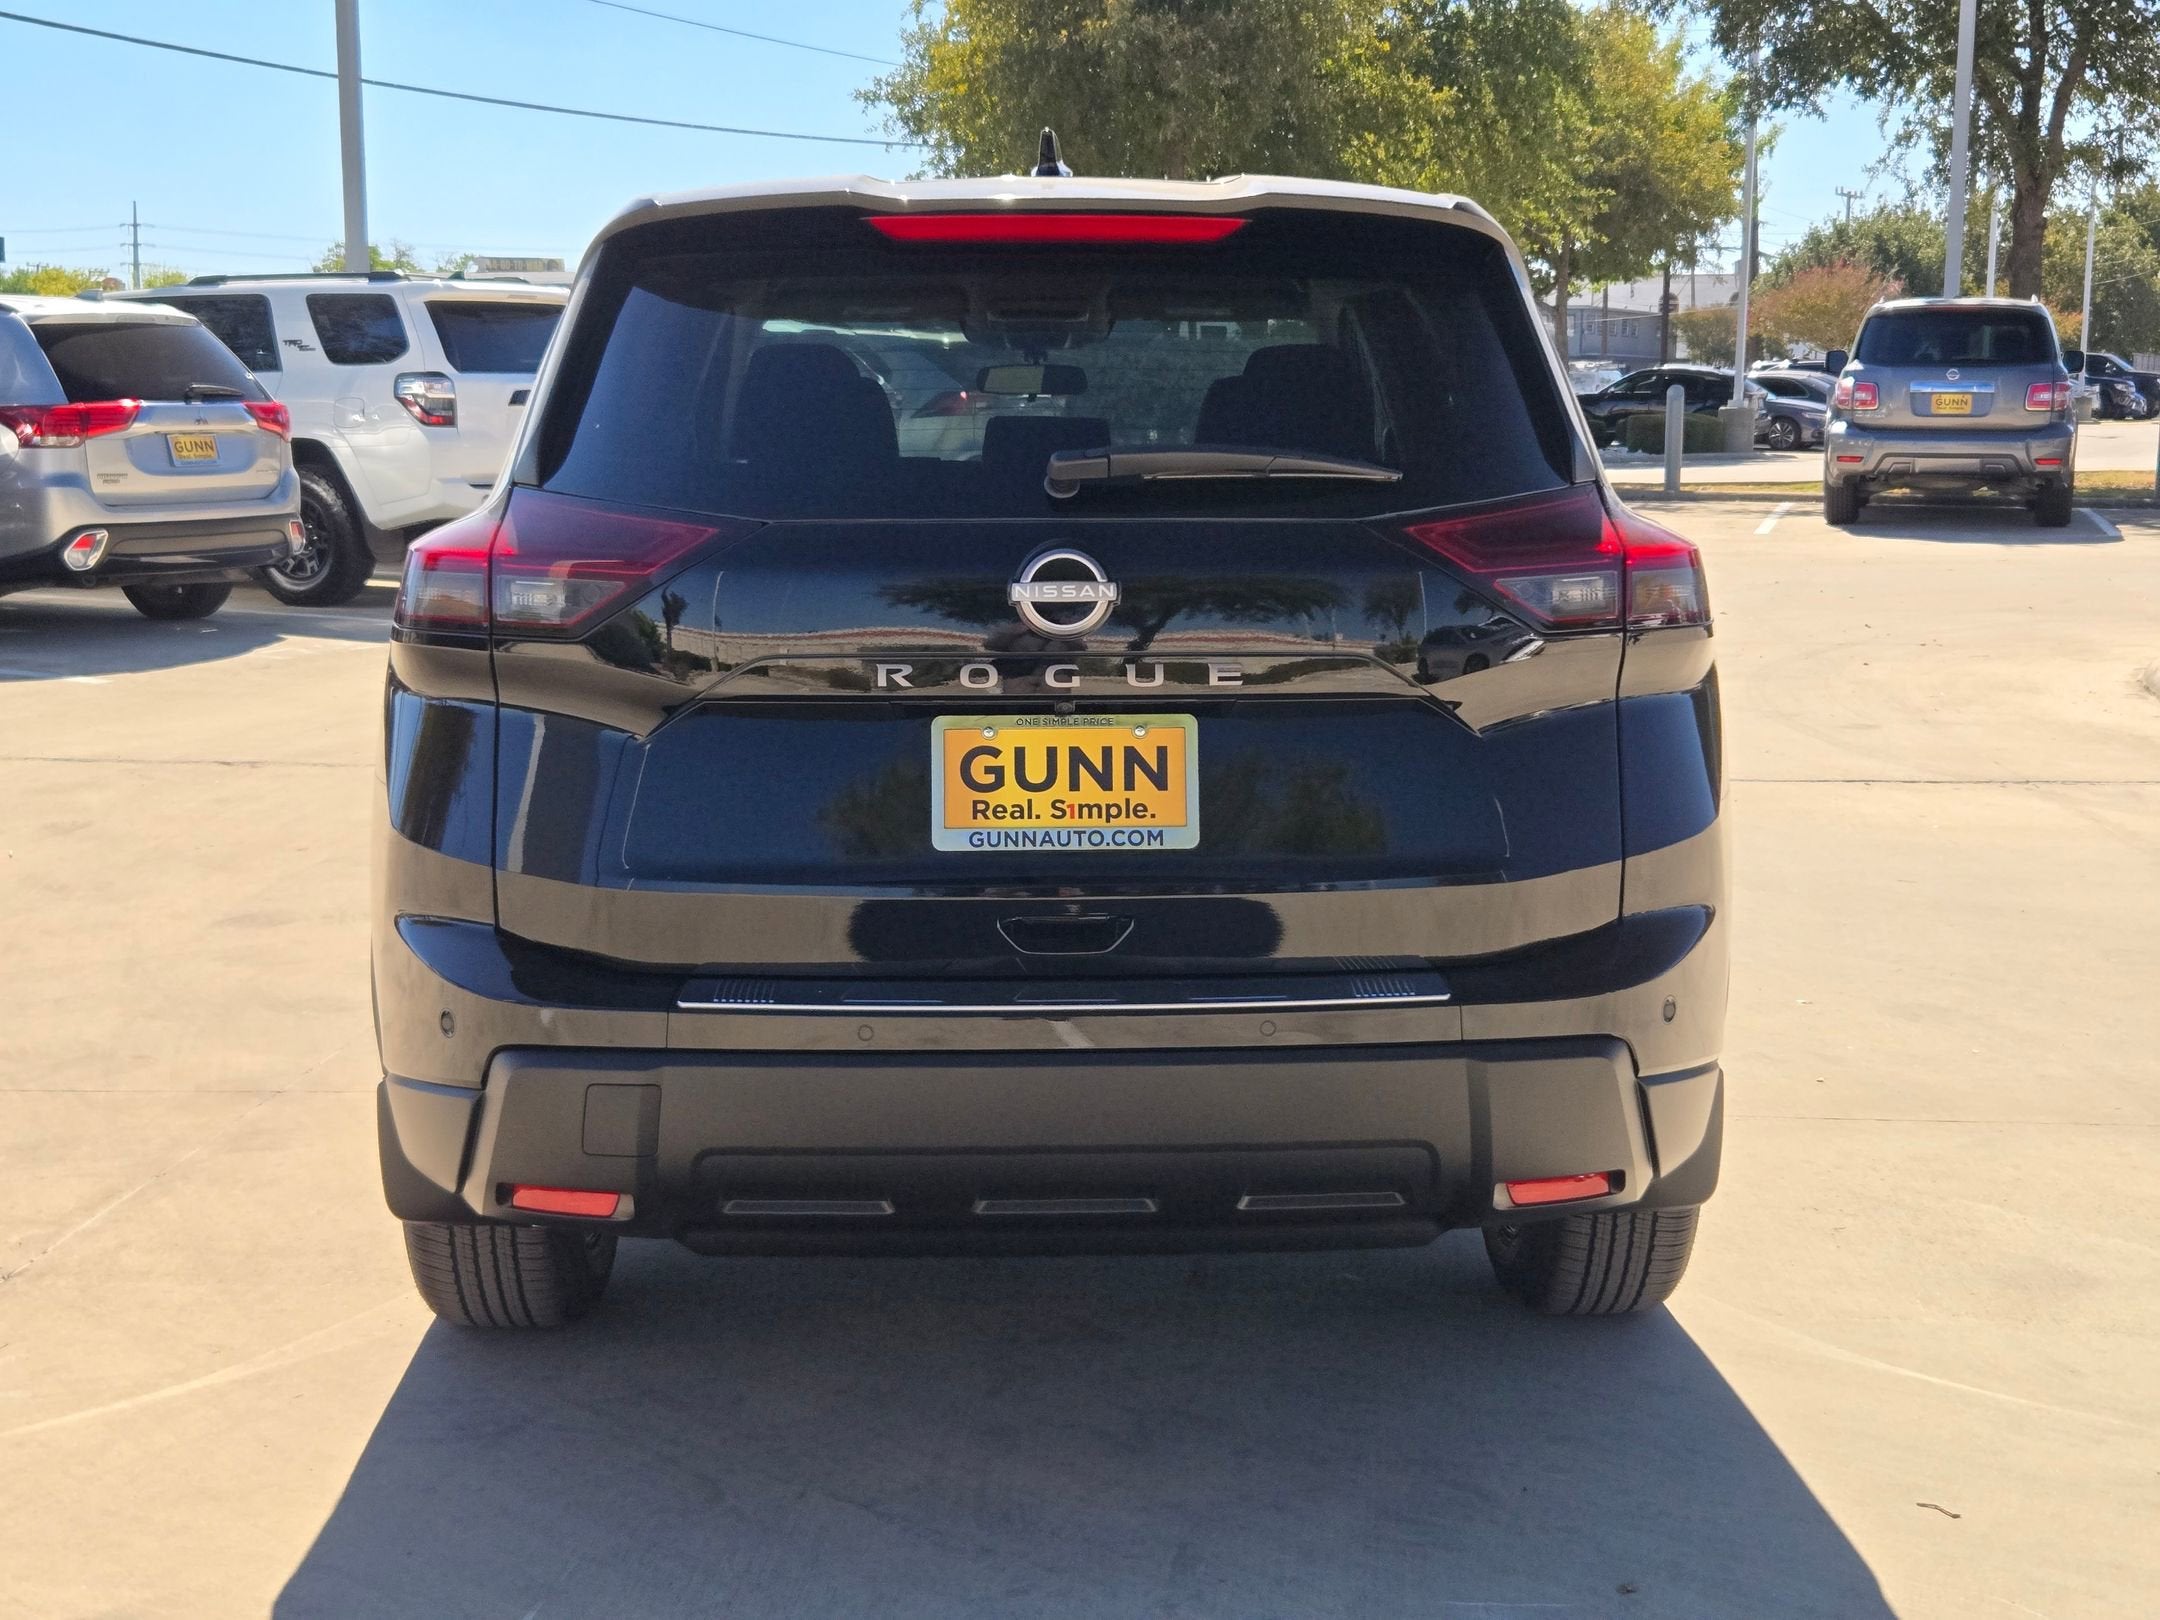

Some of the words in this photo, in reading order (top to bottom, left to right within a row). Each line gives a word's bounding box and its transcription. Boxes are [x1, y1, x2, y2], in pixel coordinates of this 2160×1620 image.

[1936, 397, 1968, 405] GUNN
[174, 439, 215, 453] GUNN
[1014, 584, 1115, 599] NISSAN
[876, 663, 1244, 688] ROGUE
[1016, 717, 1040, 726] ONE
[1042, 717, 1079, 726] SIMPLE
[1083, 717, 1115, 726] PRICE
[959, 745, 1168, 794] GUNN
[972, 800, 1041, 821] Real.
[968, 829, 1164, 848] GUNNAUTO.COM
